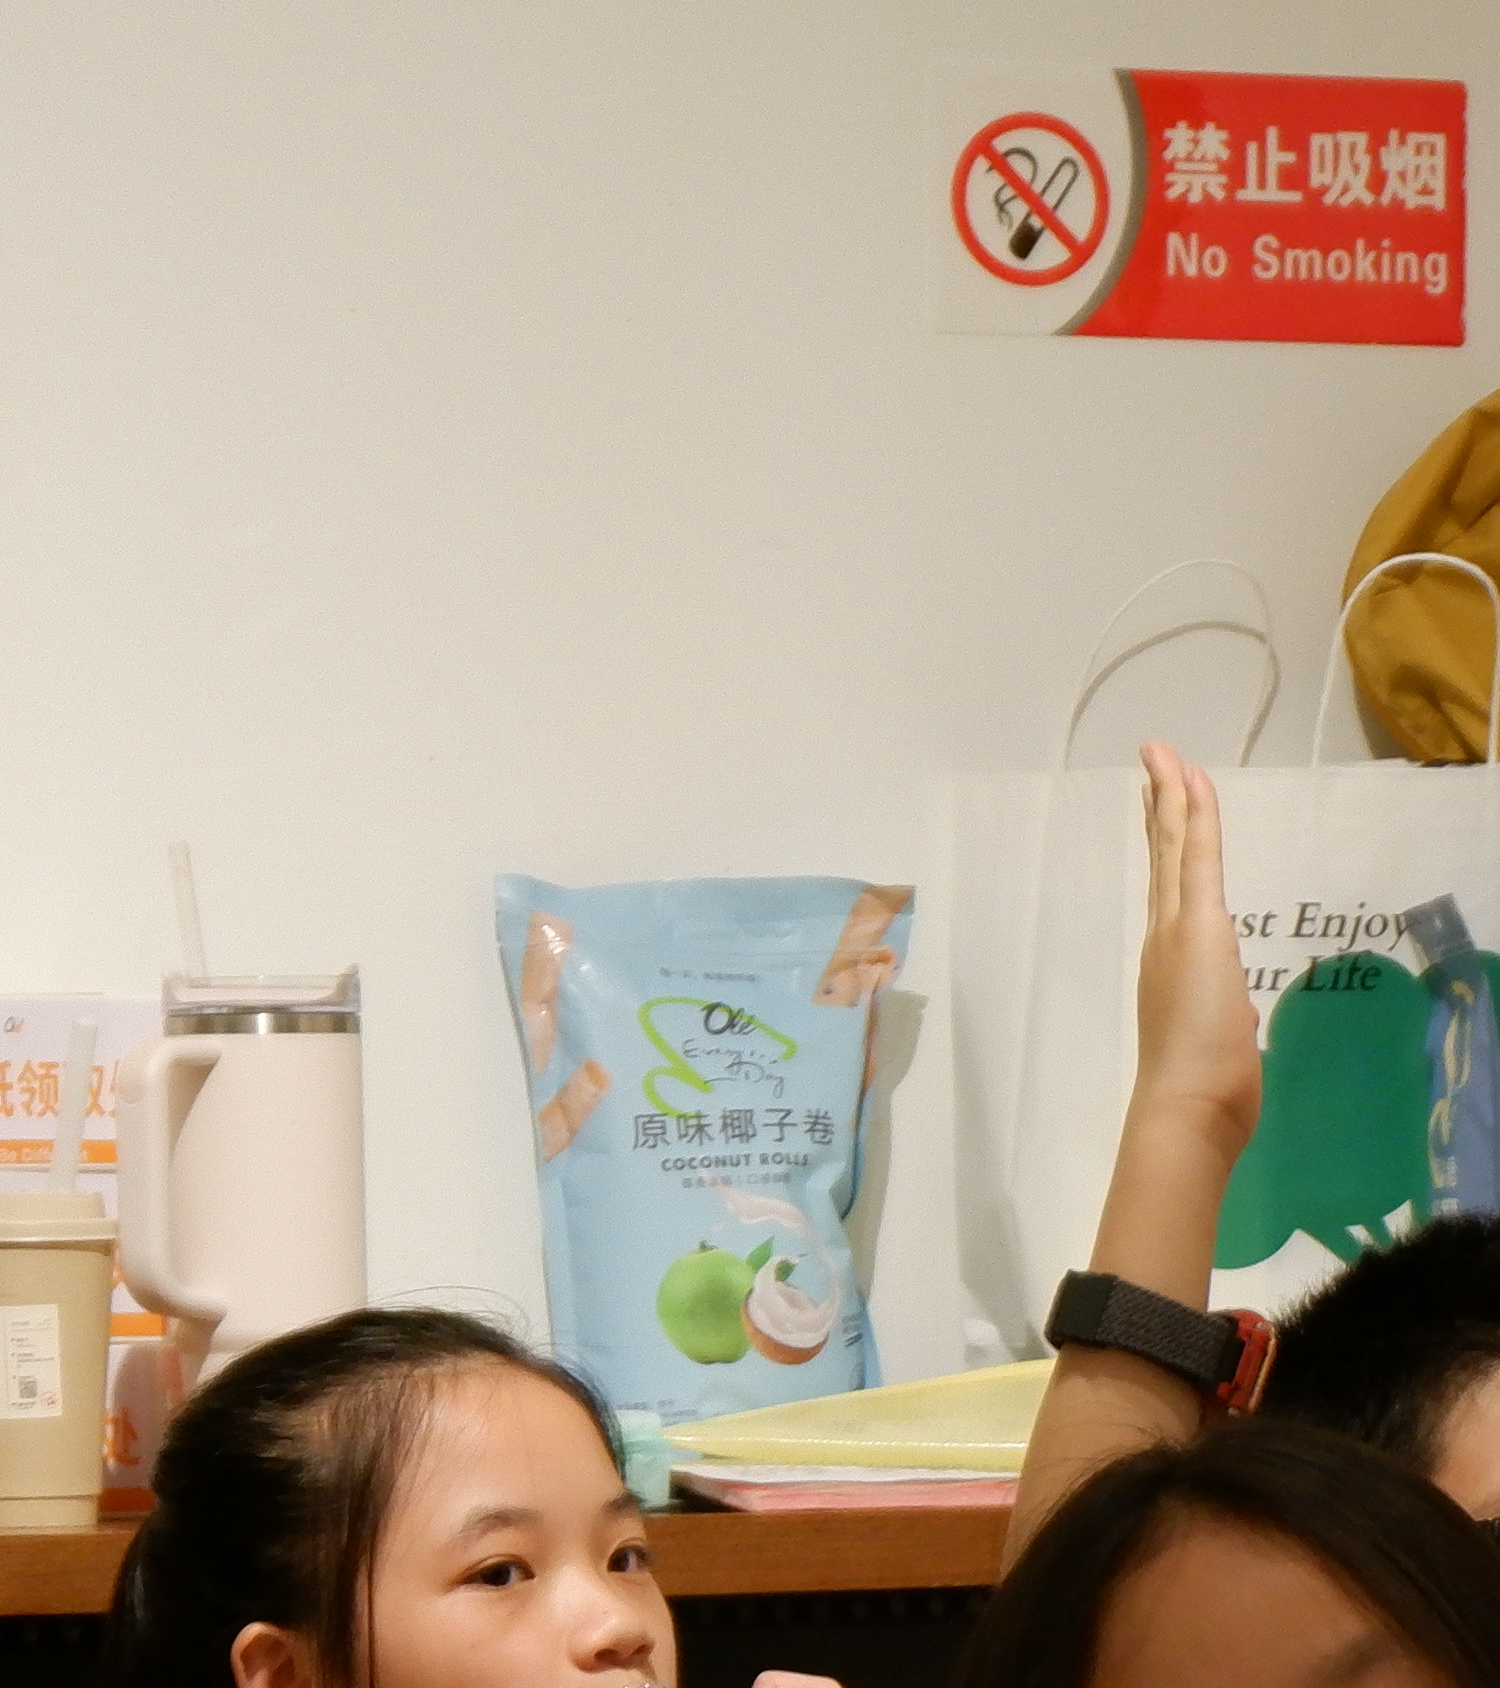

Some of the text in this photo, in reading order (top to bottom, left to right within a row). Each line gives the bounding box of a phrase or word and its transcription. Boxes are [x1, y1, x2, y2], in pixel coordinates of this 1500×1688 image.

[1161, 119, 1450, 212] 禁止吸烟
[1165, 231, 1449, 296] No Smoking
[1230, 900, 1413, 952] st Enjoy
[1243, 951, 1384, 992] ur Life
[633, 1106, 836, 1150] 原味椰子卷
[660, 1154, 751, 1173] COCONUT
